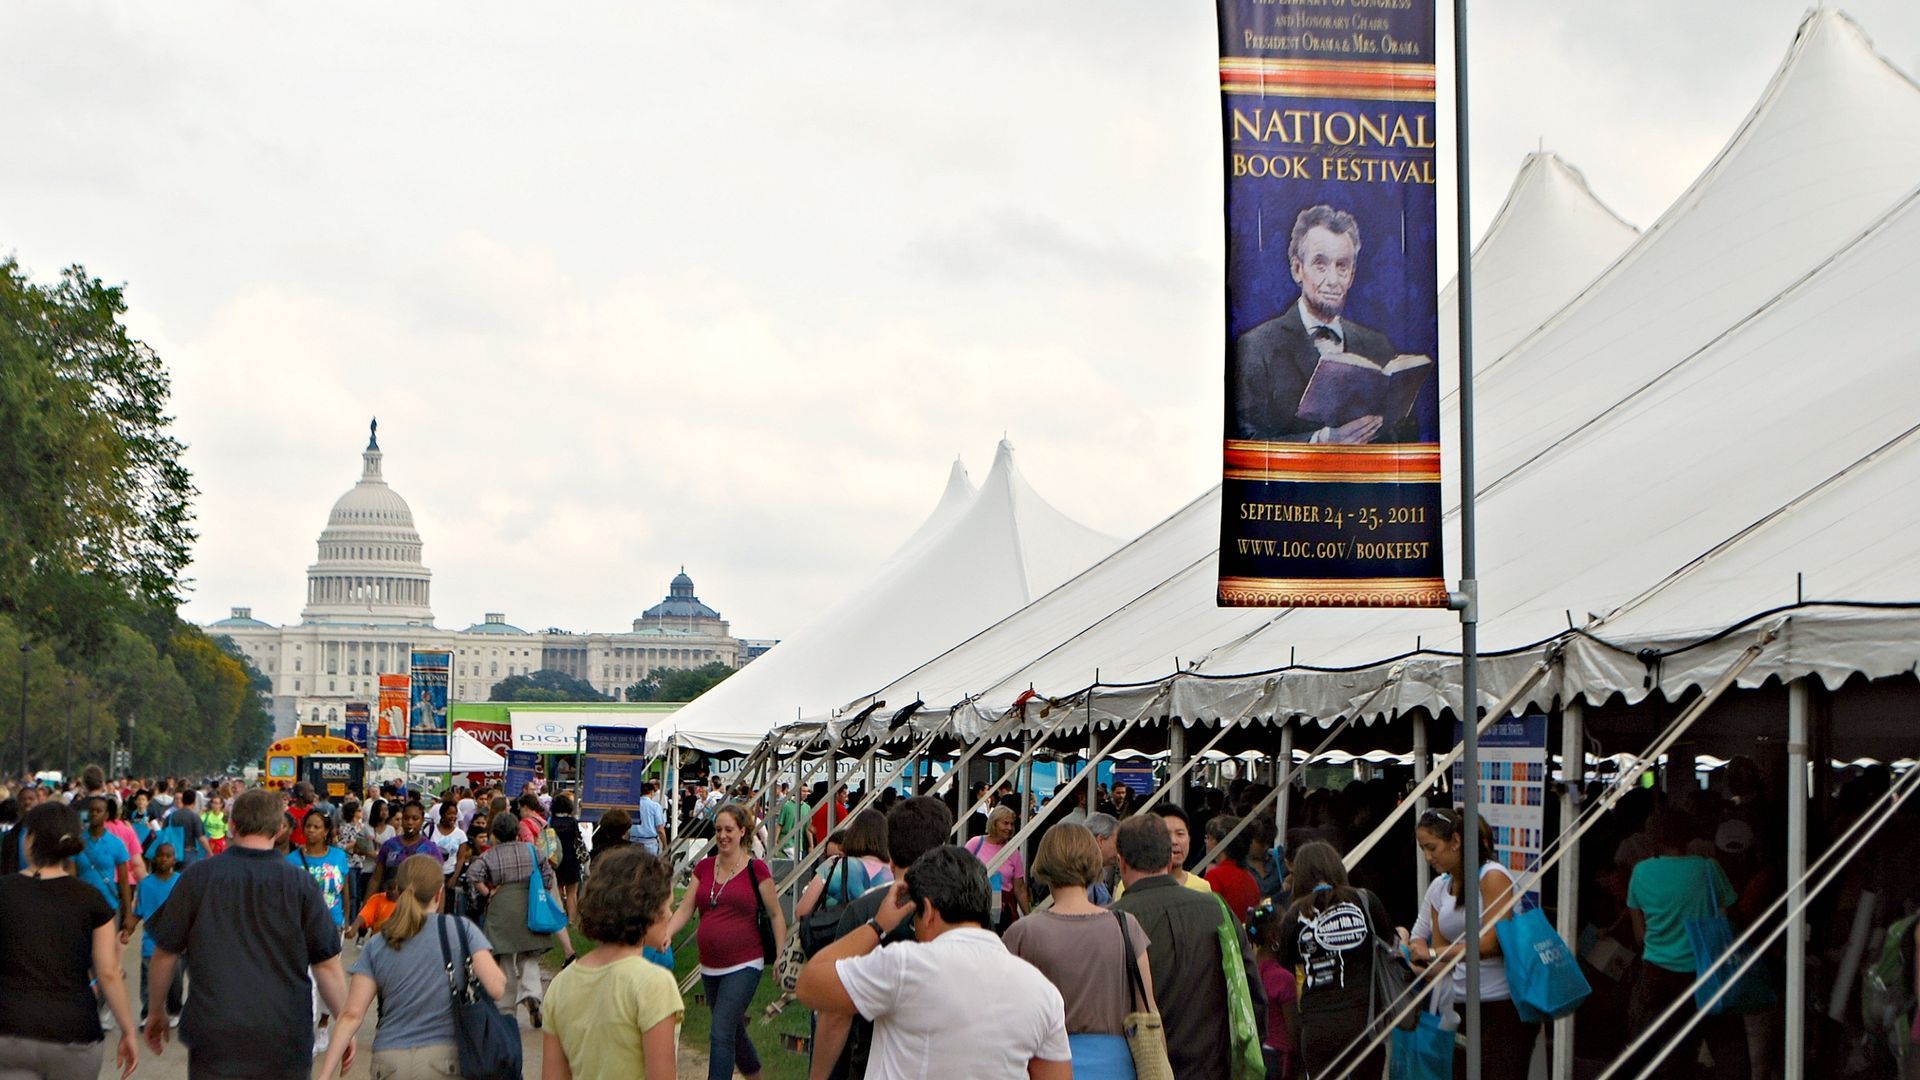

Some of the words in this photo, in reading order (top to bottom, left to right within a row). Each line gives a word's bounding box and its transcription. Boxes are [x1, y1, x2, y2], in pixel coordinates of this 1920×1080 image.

[1274, 15, 1294, 28] AND
[1296, 11, 1350, 30] HONORARY
[1351, 13, 1390, 31] CHAIRS
[1244, 29, 1300, 50] PRESIDENT
[1302, 31, 1340, 52] OBAMA
[1341, 39, 1350, 52] &
[1381, 34, 1420, 55] OBAMA
[1232, 106, 1435, 149] NATIONAL
[1232, 153, 1311, 181] BOOK
[1321, 156, 1435, 185] FESTIVAL
[1240, 502, 1319, 523] SEPTEMBER
[1388, 506, 1426, 524] 2011
[321, 762, 351, 770] KOHLER
